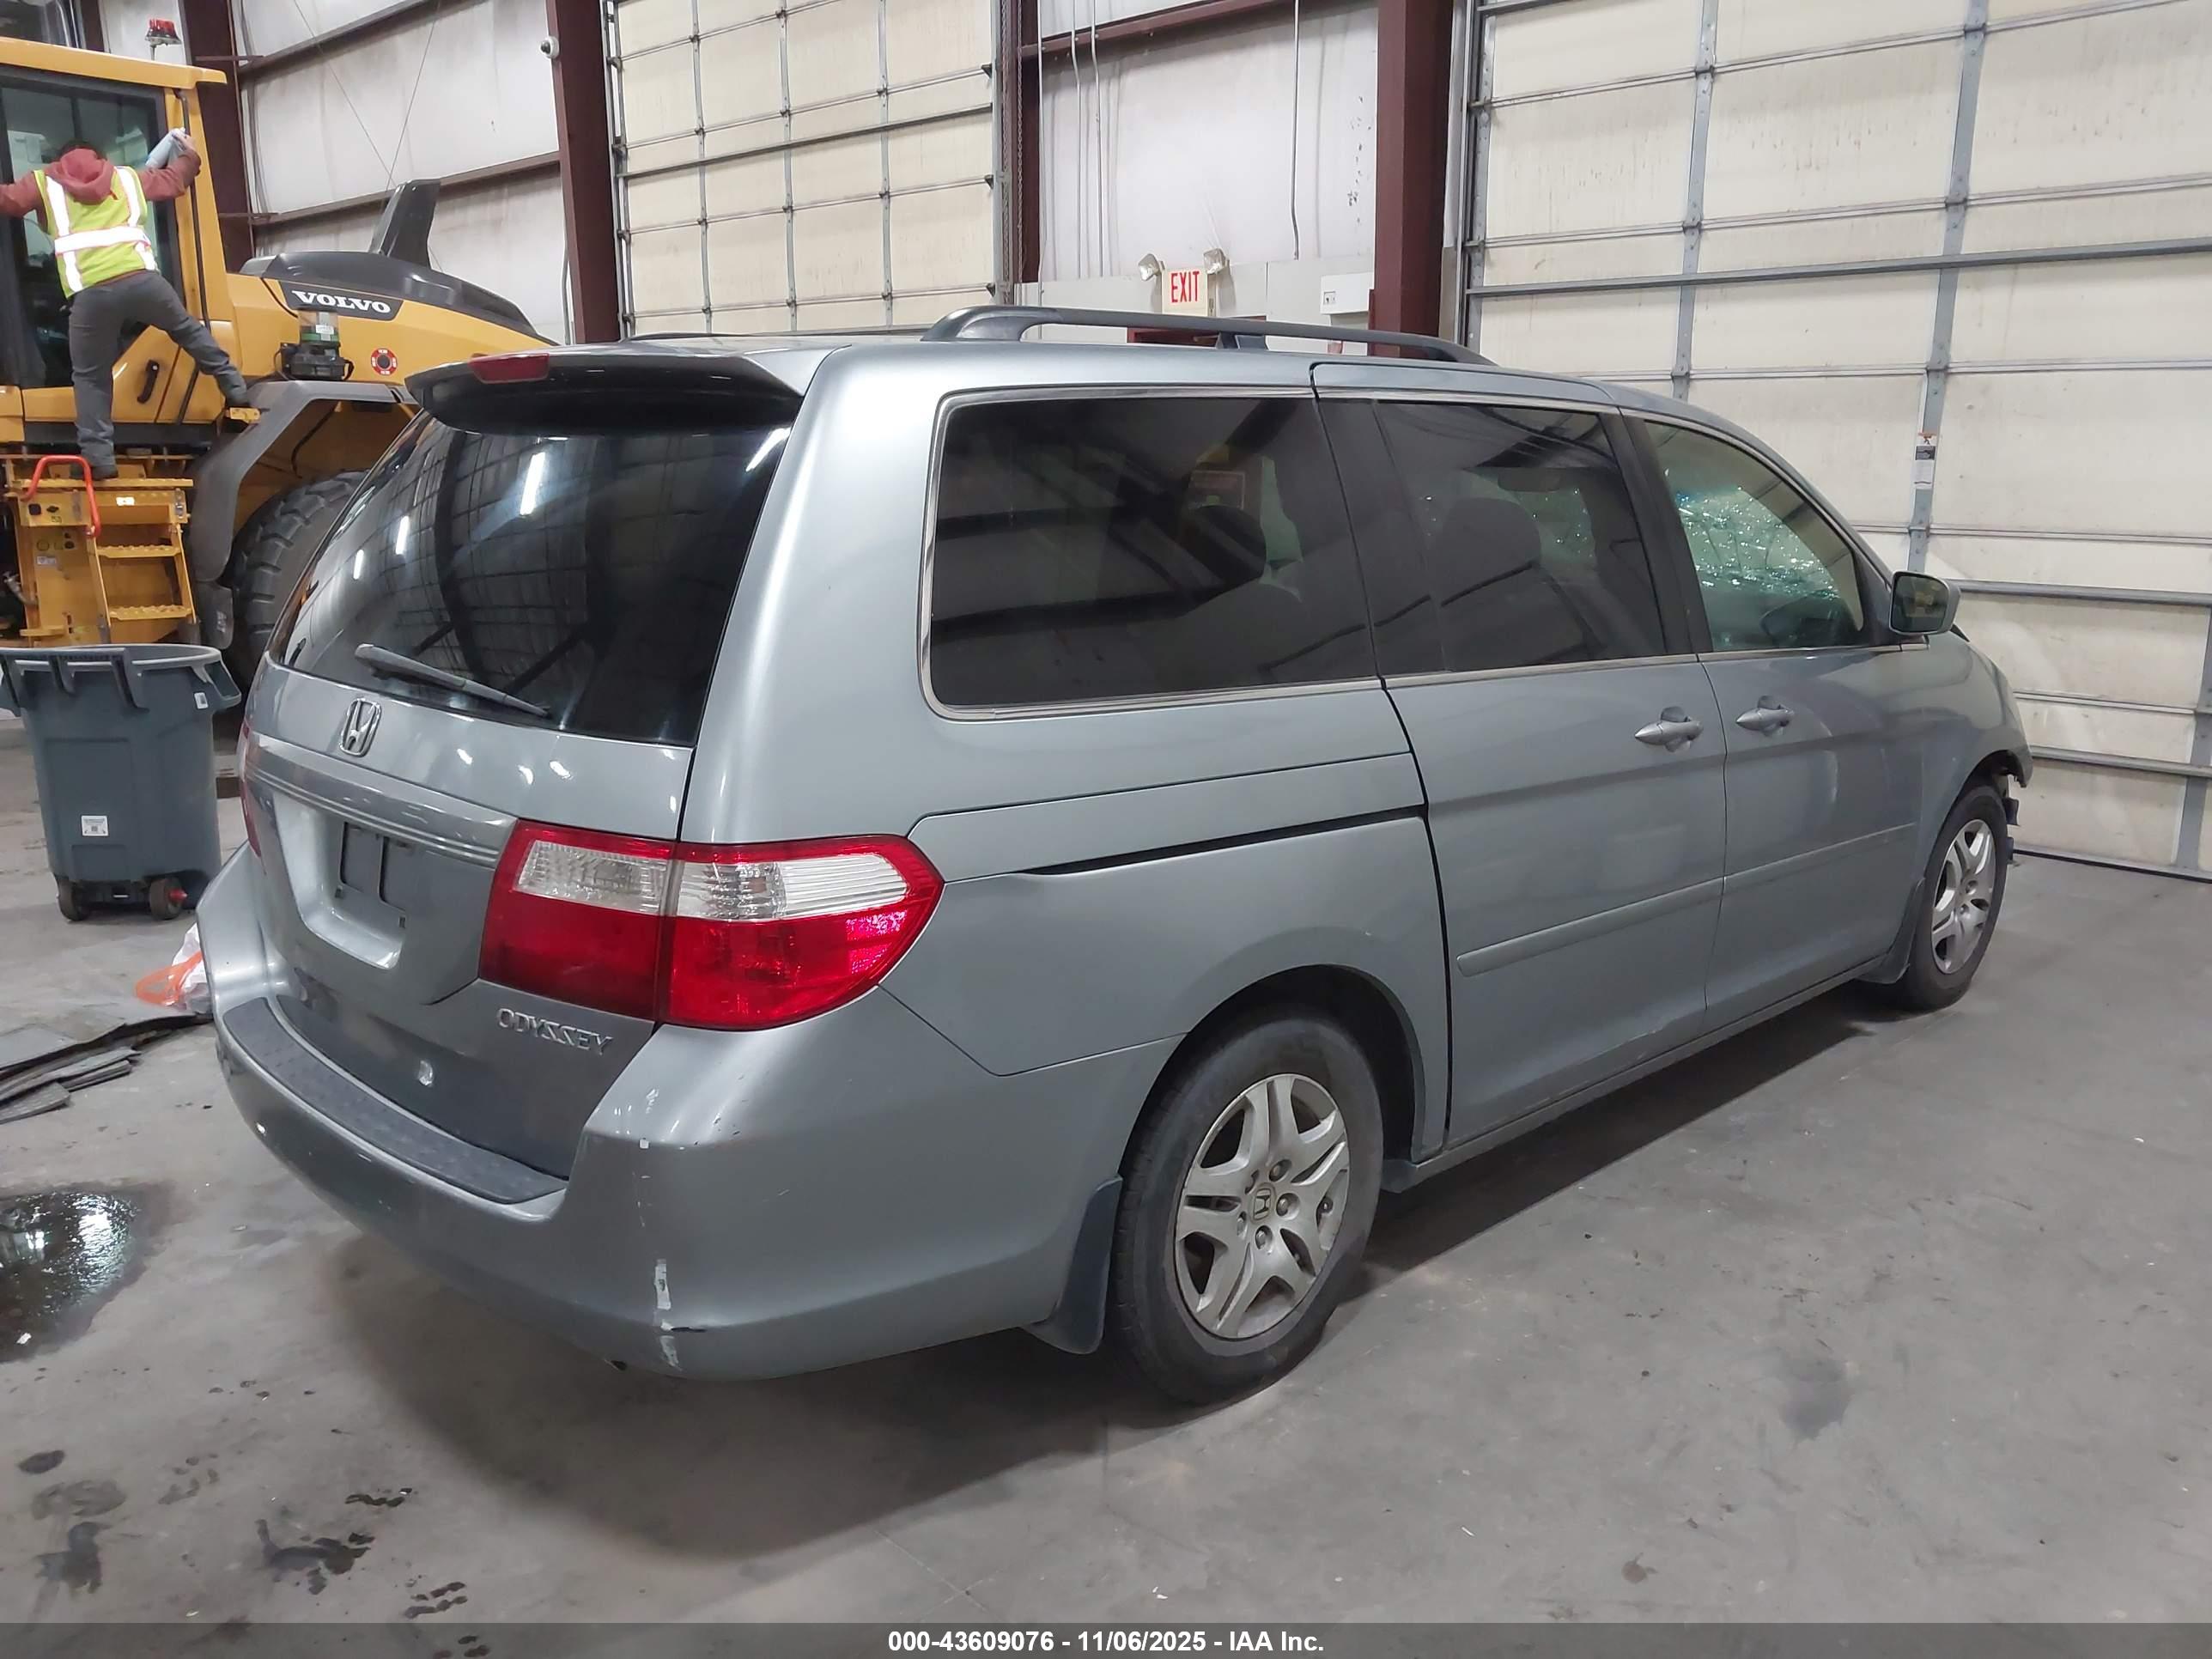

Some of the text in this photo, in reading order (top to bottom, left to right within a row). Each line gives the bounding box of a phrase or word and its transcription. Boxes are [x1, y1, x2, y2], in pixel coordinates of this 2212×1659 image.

[291, 290, 392, 313] VOLVO
[1171, 270, 1200, 303] EXIT
[497, 1007, 613, 1055] ODYSSEY
